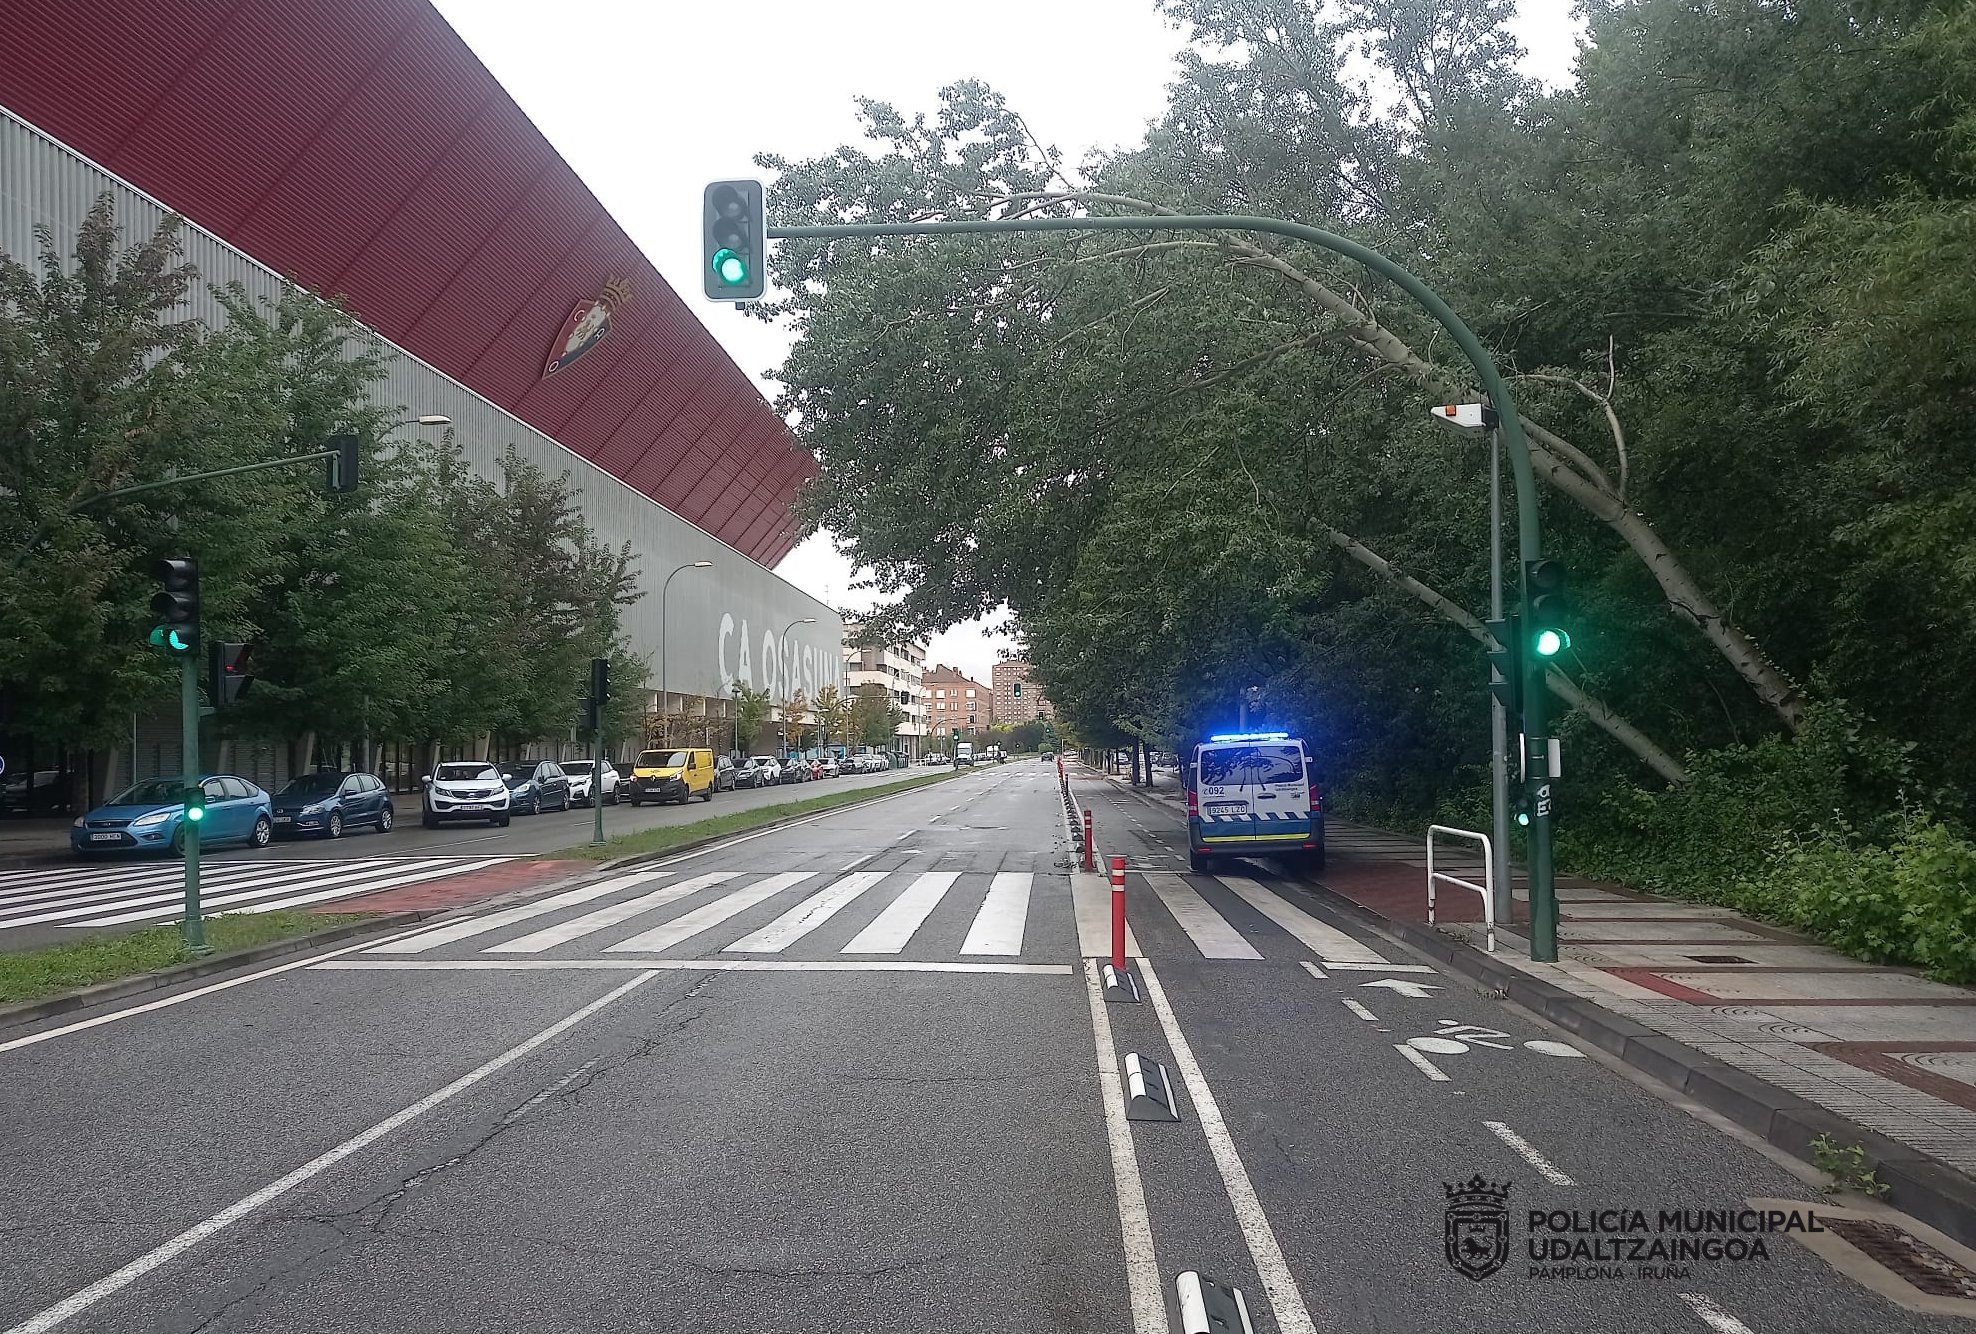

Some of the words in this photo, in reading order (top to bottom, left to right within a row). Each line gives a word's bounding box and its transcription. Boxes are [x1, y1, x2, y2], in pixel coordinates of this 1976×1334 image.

[718, 613, 753, 697] CA
[762, 629, 841, 704] OSASUNA
[1208, 786, 1225, 795] 092
[1212, 806, 1229, 814] 9245
